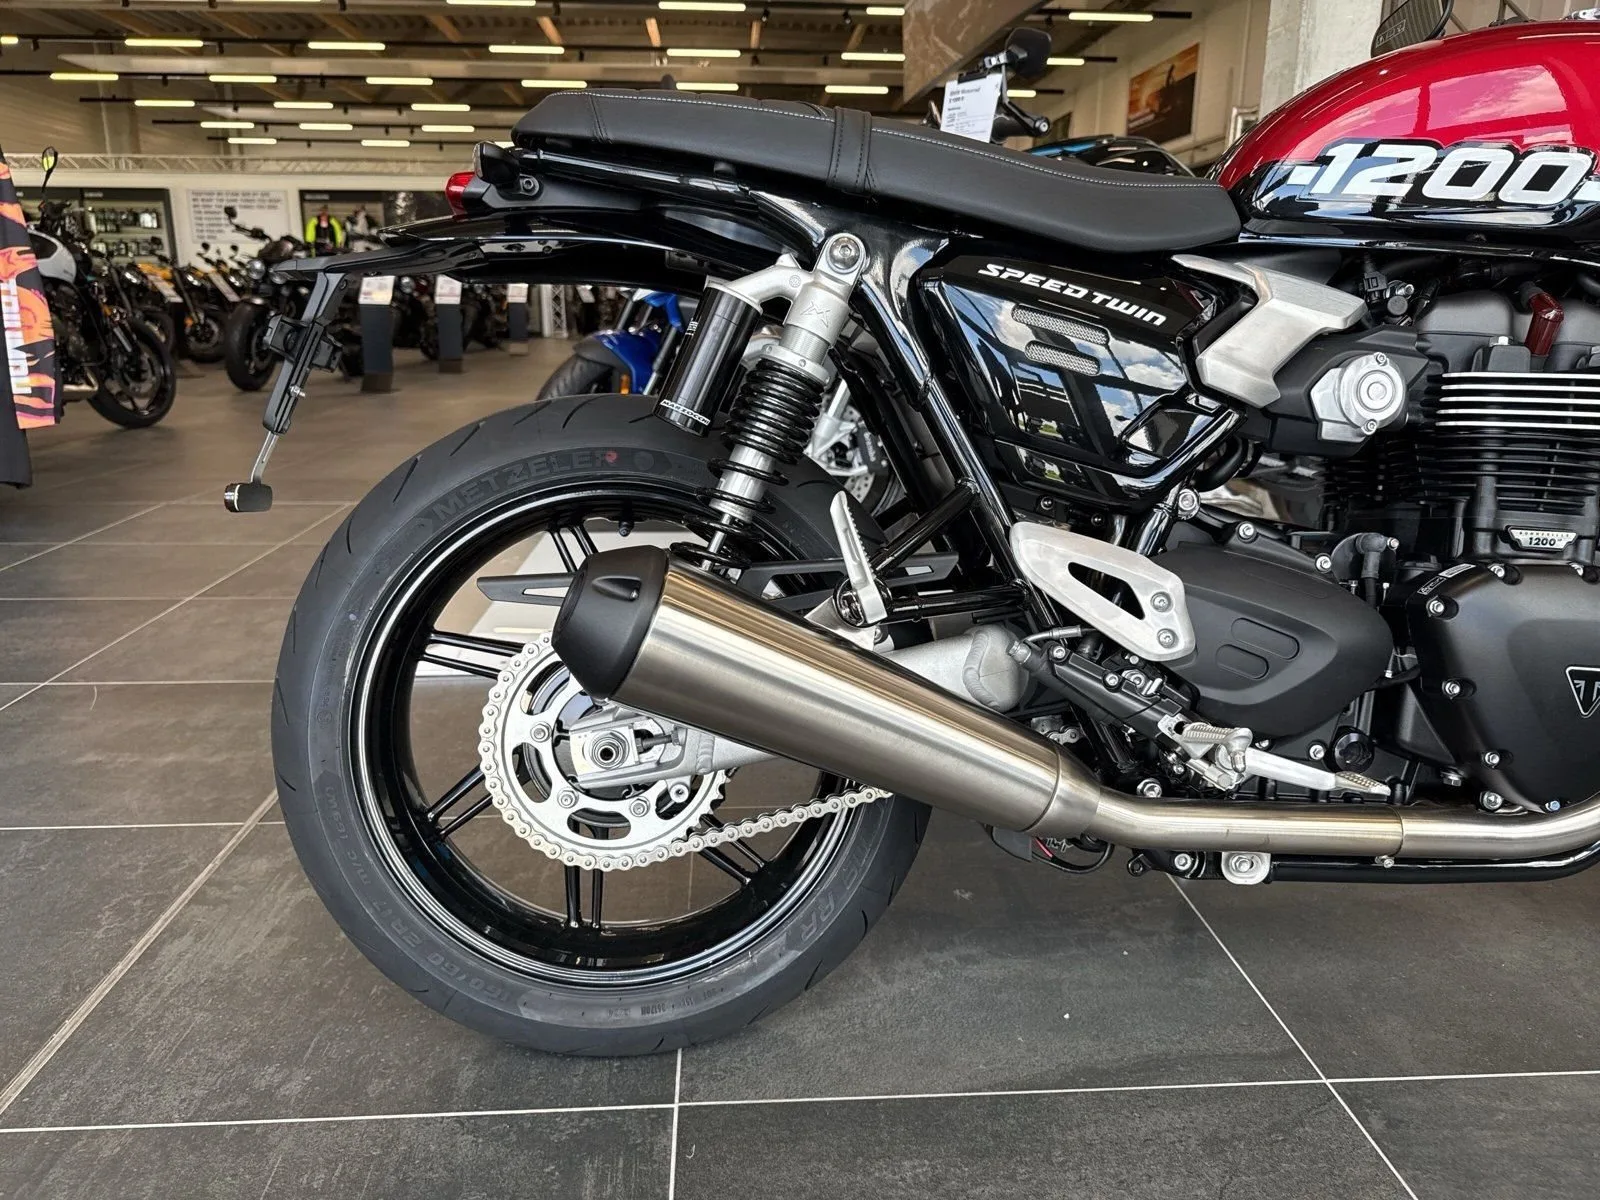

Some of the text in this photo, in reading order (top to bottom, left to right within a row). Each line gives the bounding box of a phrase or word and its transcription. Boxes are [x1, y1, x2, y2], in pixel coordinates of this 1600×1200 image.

[1311, 142, 1592, 205] 1200
[978, 263, 1167, 326] SPEED TWIN
[661, 399, 711, 426] MARZOCCHI
[435, 449, 618, 522] METZELER
[1529, 537, 1556, 546] 1200
